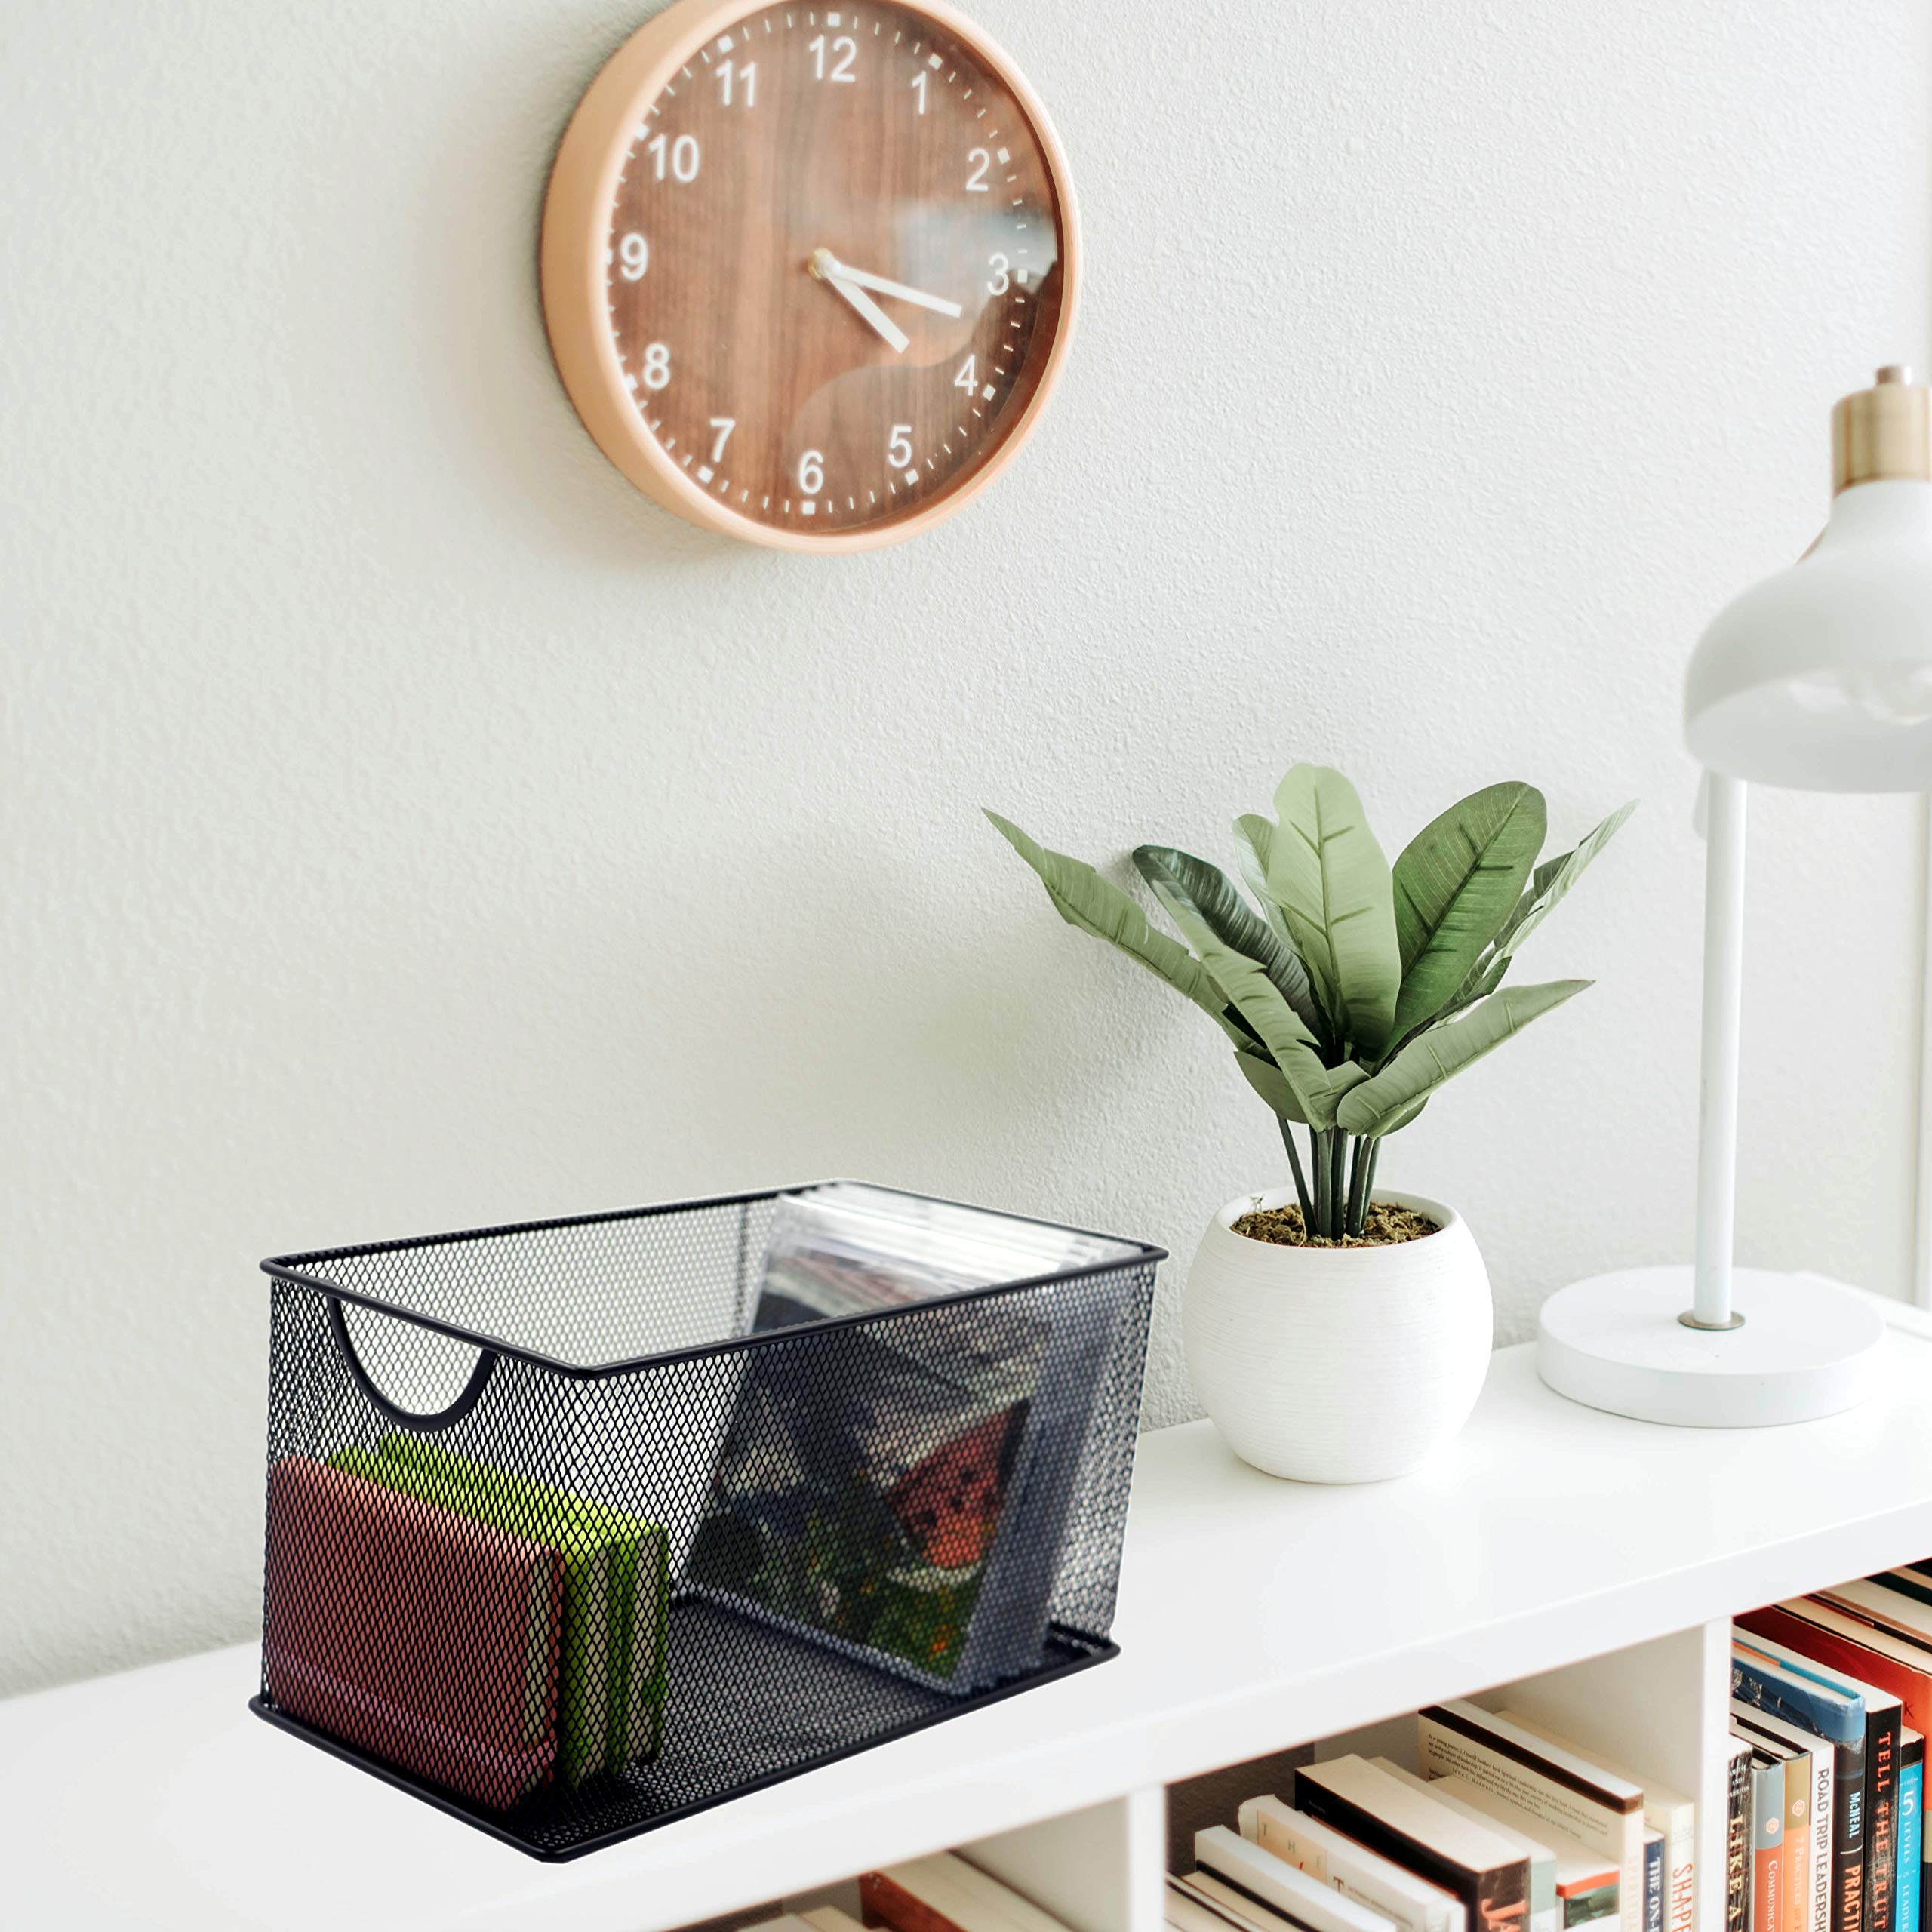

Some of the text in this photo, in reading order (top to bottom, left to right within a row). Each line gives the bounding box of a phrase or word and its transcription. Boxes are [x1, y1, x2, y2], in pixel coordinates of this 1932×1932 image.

[809, 36, 857, 83] 12
[716, 61, 756, 107] 11
[912, 72, 928, 114] 1
[648, 134, 700, 182] 10
[966, 149, 989, 191] 2
[620, 234, 648, 281] 9
[986, 253, 1008, 297] 3
[643, 344, 670, 389] 8
[955, 355, 978, 396] 4
[709, 418, 736, 463] 7
[888, 425, 912, 468] 5
[797, 449, 823, 494] 6
[1849, 1791, 1861, 1839] McNEAL
[1902, 1790, 1915, 1816] 5
[1814, 1768, 1829, 1932] ROAD TRIP LEADERSH
[1873, 1731, 1890, 1929] TELL THE TRUT
[1903, 1820, 1912, 1863] LEVELS
[1649, 1856, 1660, 1894] THE
[1729, 1814, 1743, 1924] LIKE A
[1901, 1884, 1910, 1932] LEADER
